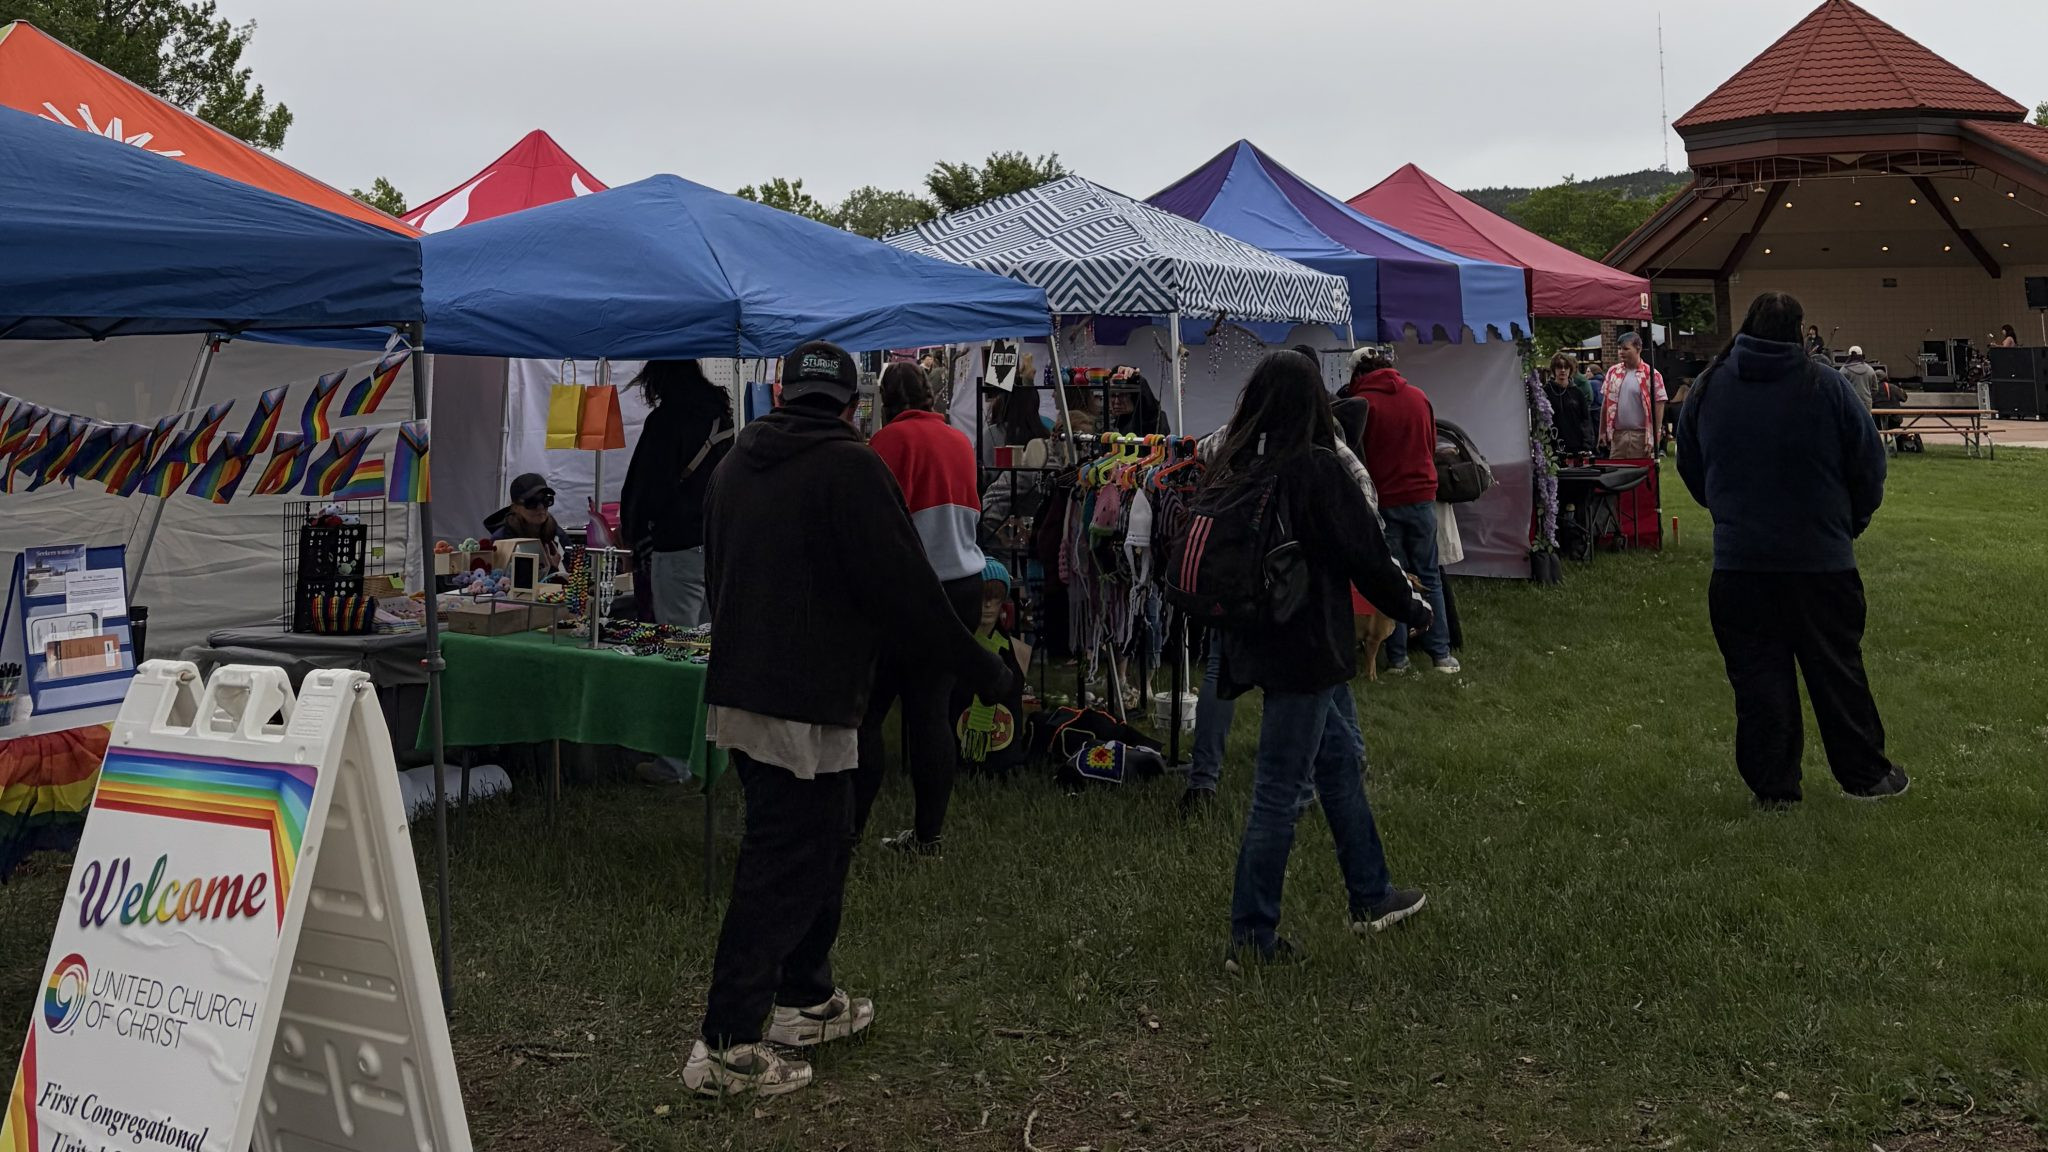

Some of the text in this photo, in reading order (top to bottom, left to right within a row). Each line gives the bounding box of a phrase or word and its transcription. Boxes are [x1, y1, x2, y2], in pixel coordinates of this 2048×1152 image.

[79, 853, 268, 928] Welcome
[85, 1000, 188, 1049] OF CHRIST
[92, 968, 257, 1031] UNITED CHURCH
[37, 1081, 209, 1152] First Congregational
